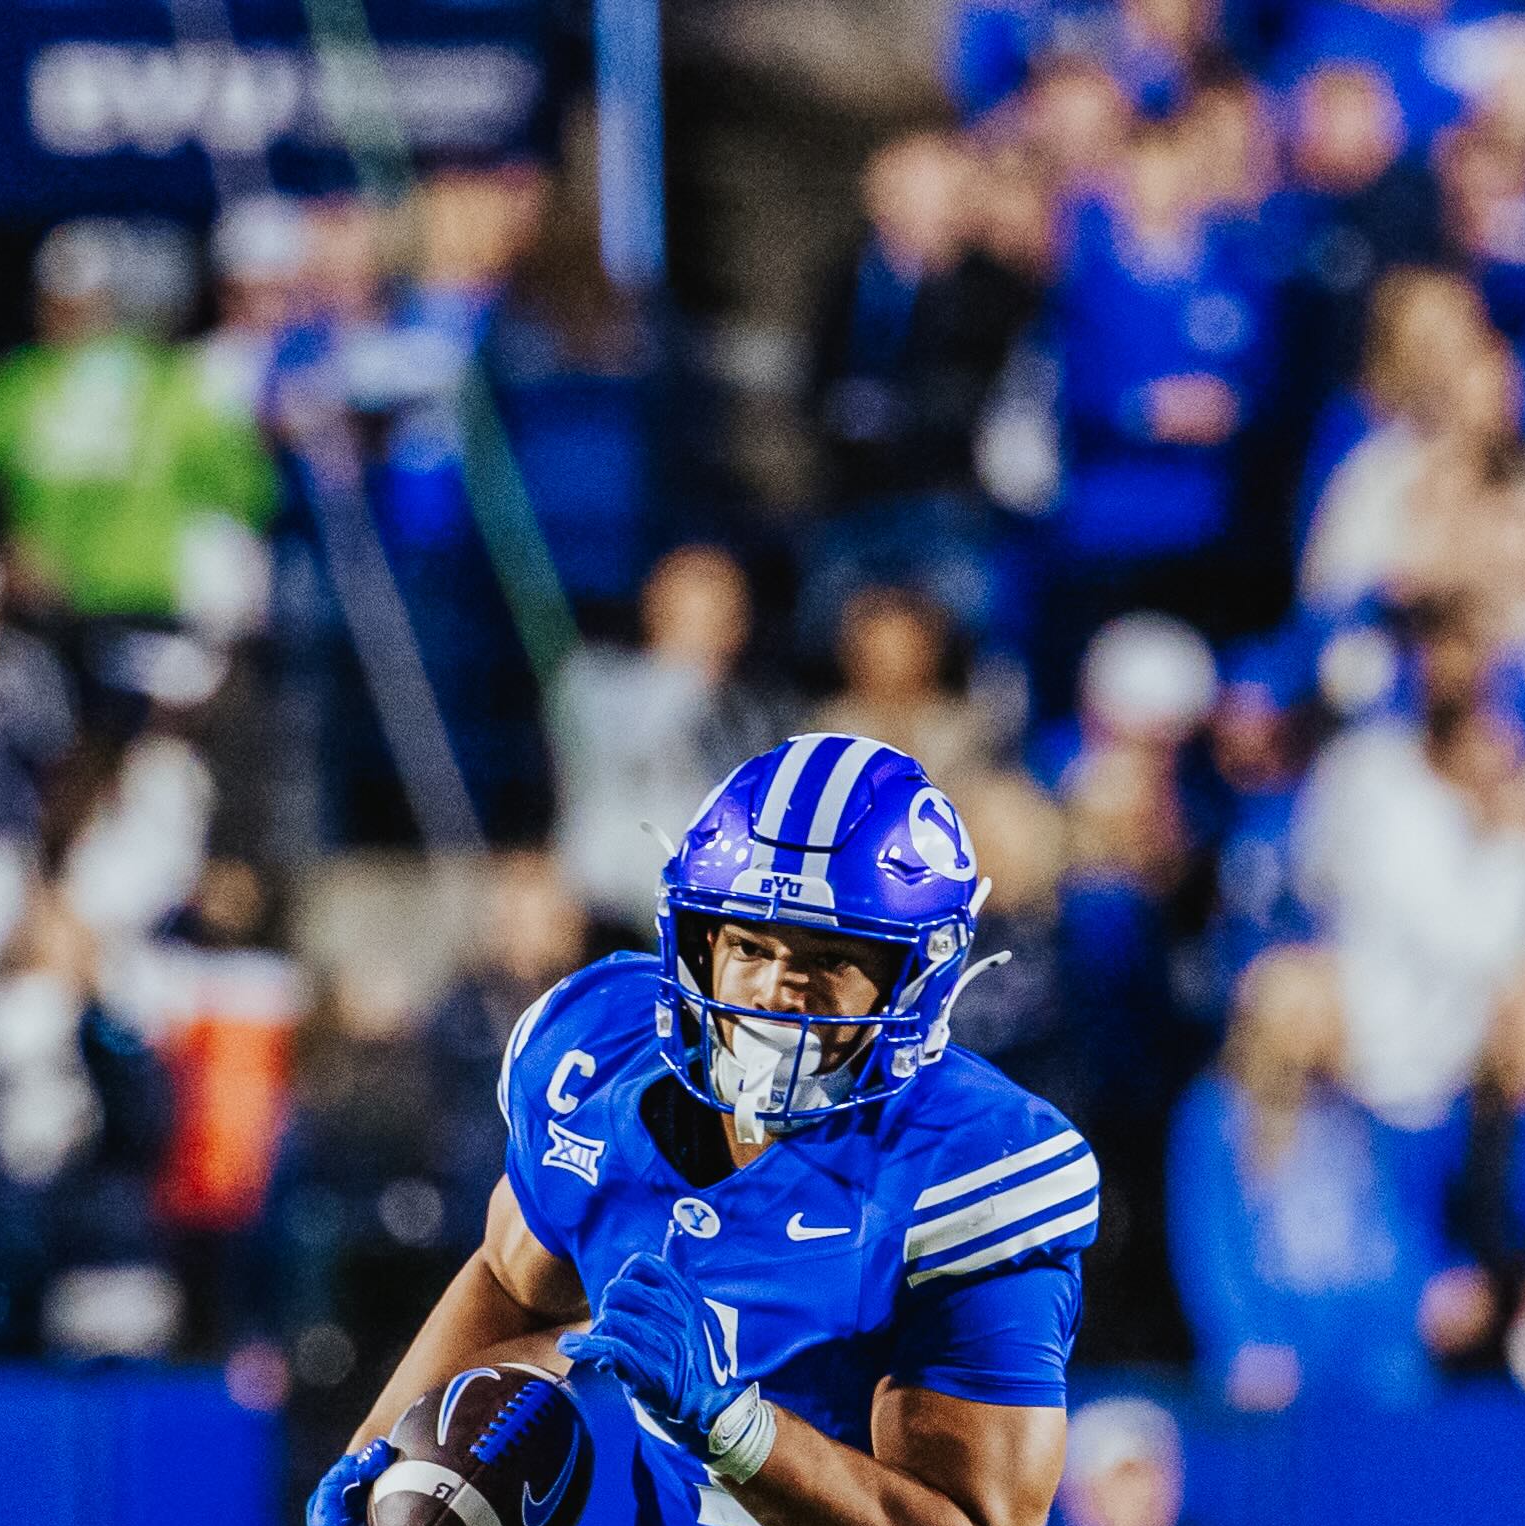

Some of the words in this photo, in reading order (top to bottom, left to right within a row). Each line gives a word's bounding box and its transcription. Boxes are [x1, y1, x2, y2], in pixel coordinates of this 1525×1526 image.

[759, 875, 804, 898] BYU
[546, 1048, 597, 1115] C
[679, 1202, 714, 1233] Y
